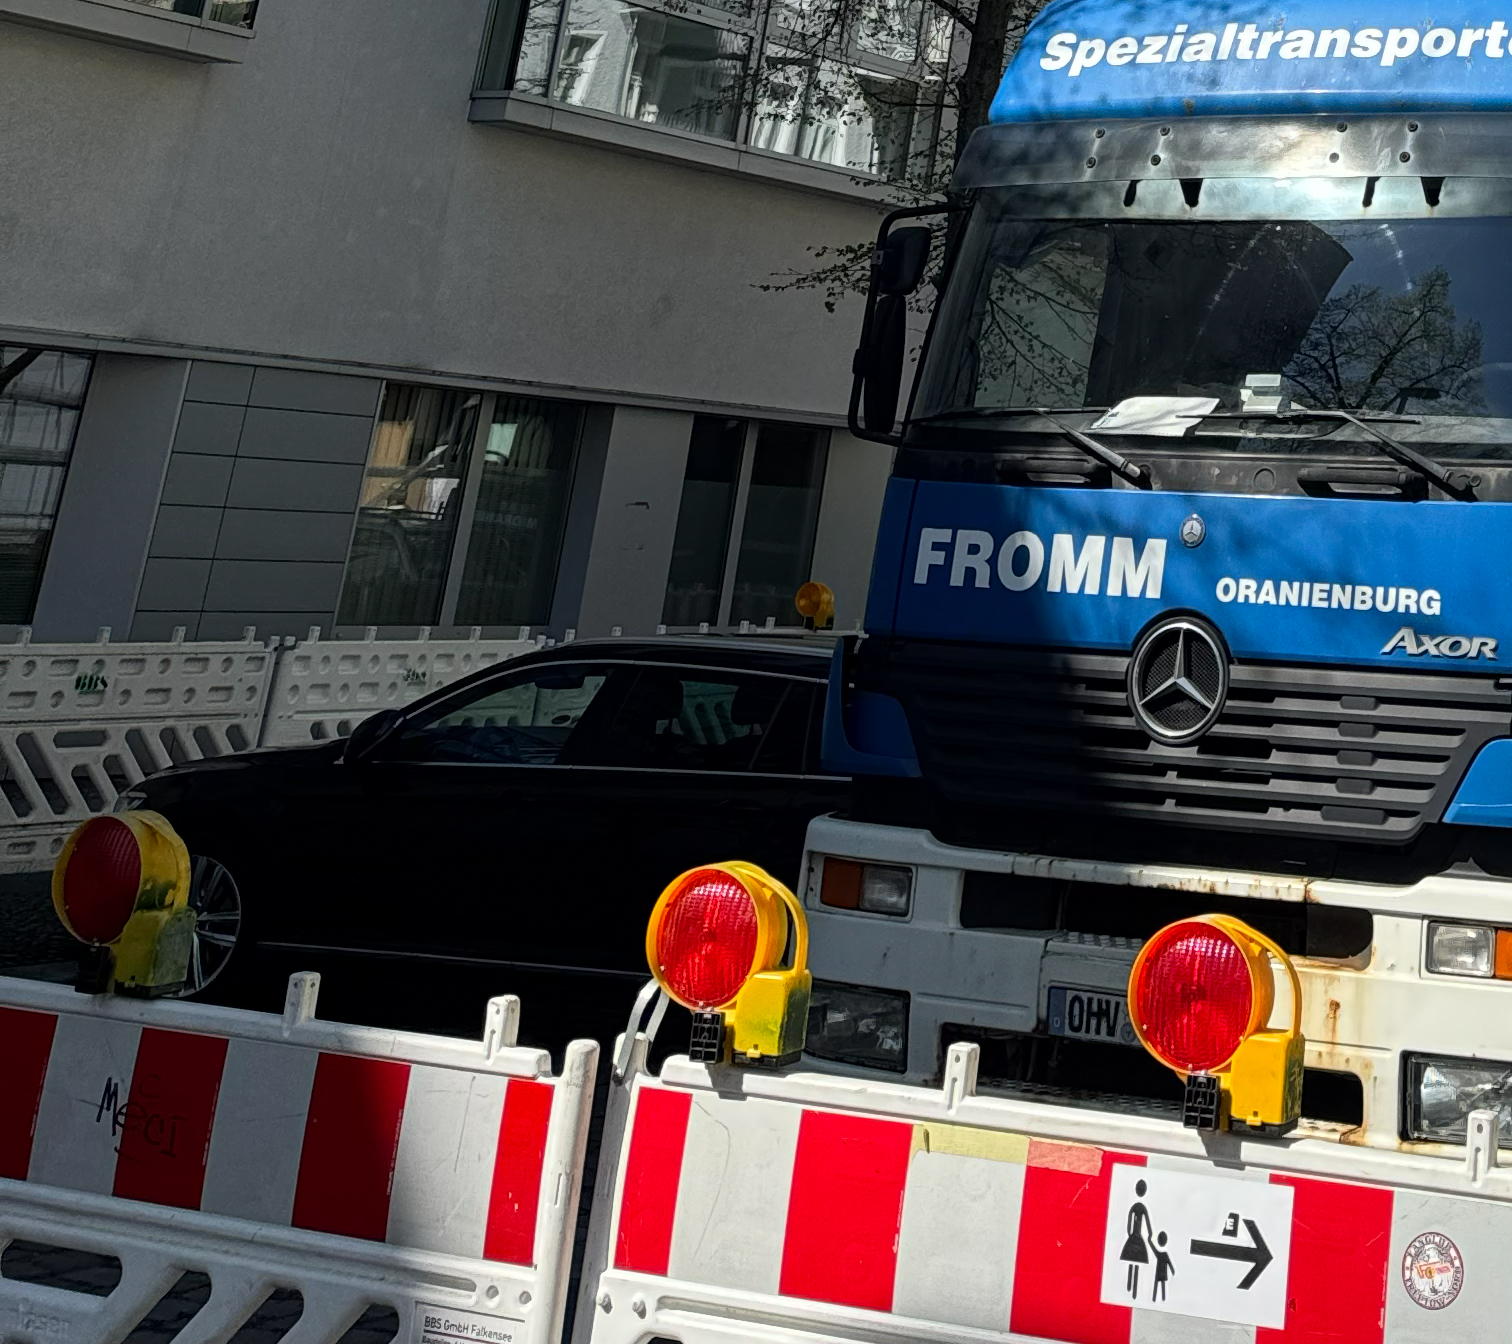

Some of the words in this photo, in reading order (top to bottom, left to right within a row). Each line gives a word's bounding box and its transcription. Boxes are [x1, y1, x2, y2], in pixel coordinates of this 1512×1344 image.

[913, 527, 1168, 600] FROMM
[1214, 576, 1442, 616] ORANIENBURG
[1380, 627, 1499, 661] AXOR
[1067, 994, 1121, 1038] OHV
[423, 1315, 442, 1330] BBS
[443, 1319, 470, 1335] GmbH
[471, 1324, 513, 1343] Falkensee
